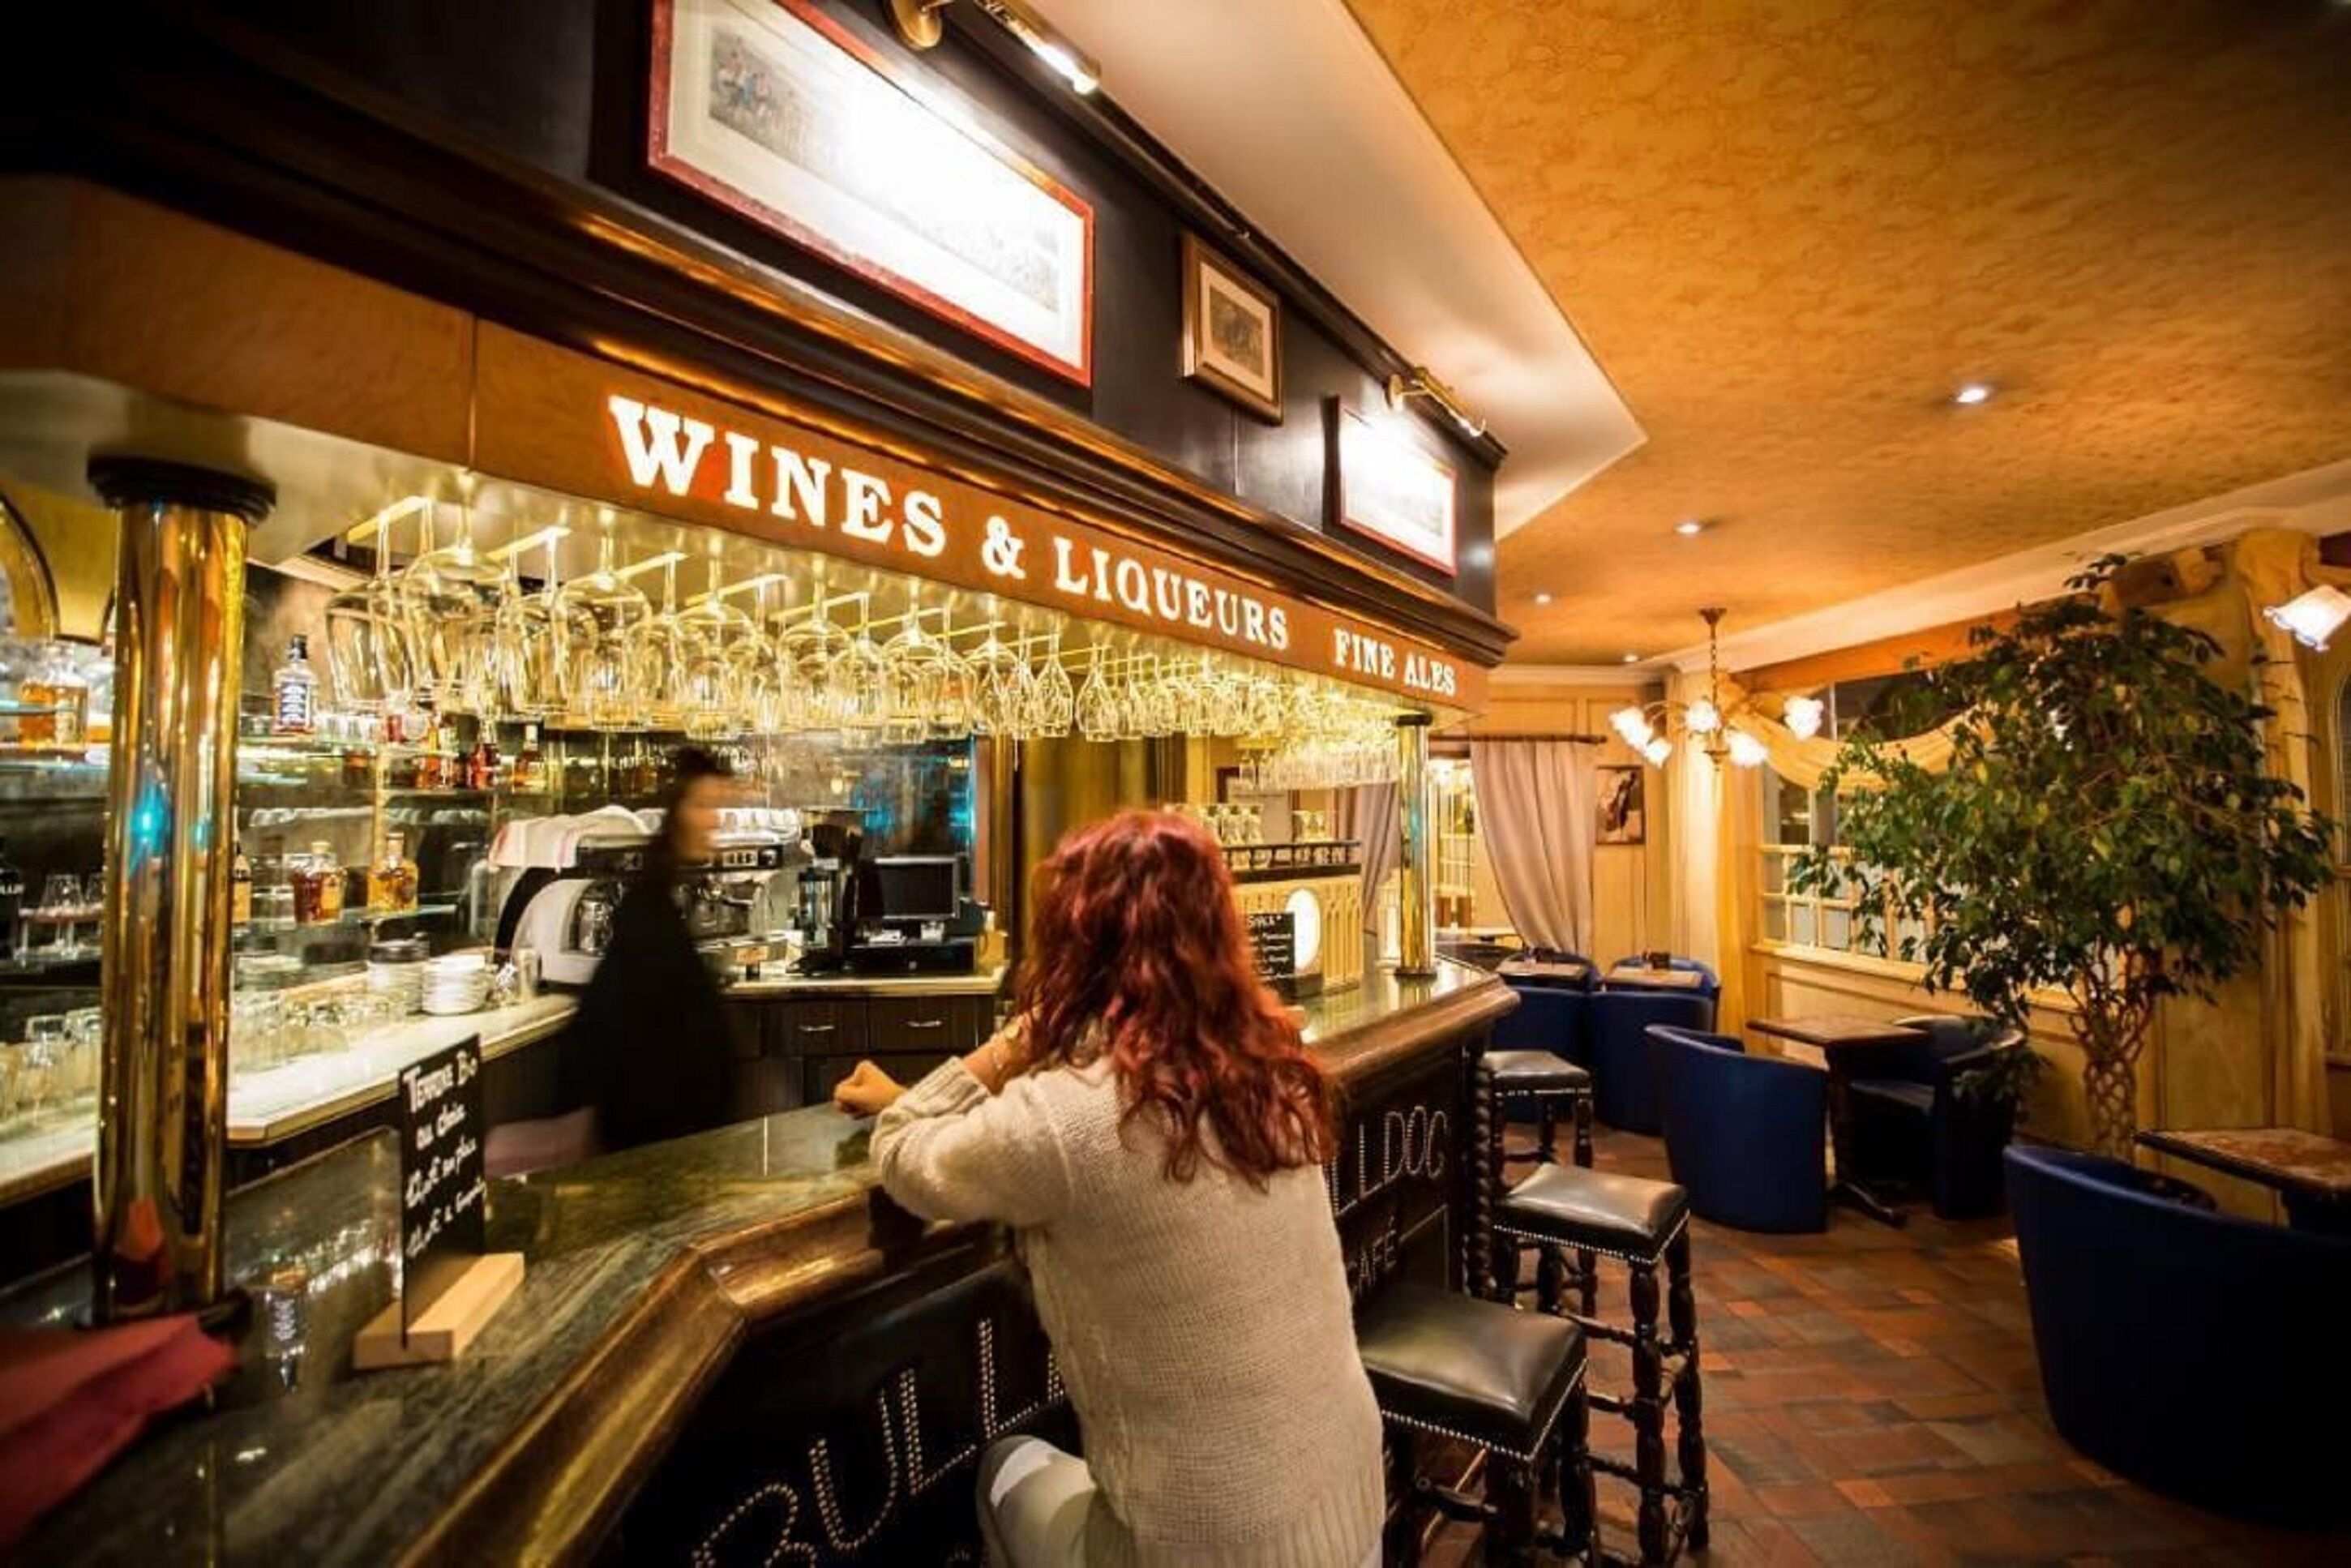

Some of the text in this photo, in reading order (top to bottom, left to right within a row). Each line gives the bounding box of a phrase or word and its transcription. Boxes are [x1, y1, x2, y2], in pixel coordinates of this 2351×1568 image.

[608, 395, 1456, 697] WINES & LIQUEURS FINE ALES
[1322, 1104, 1450, 1218] LLDOG
[692, 1316, 1064, 1568] BULL
